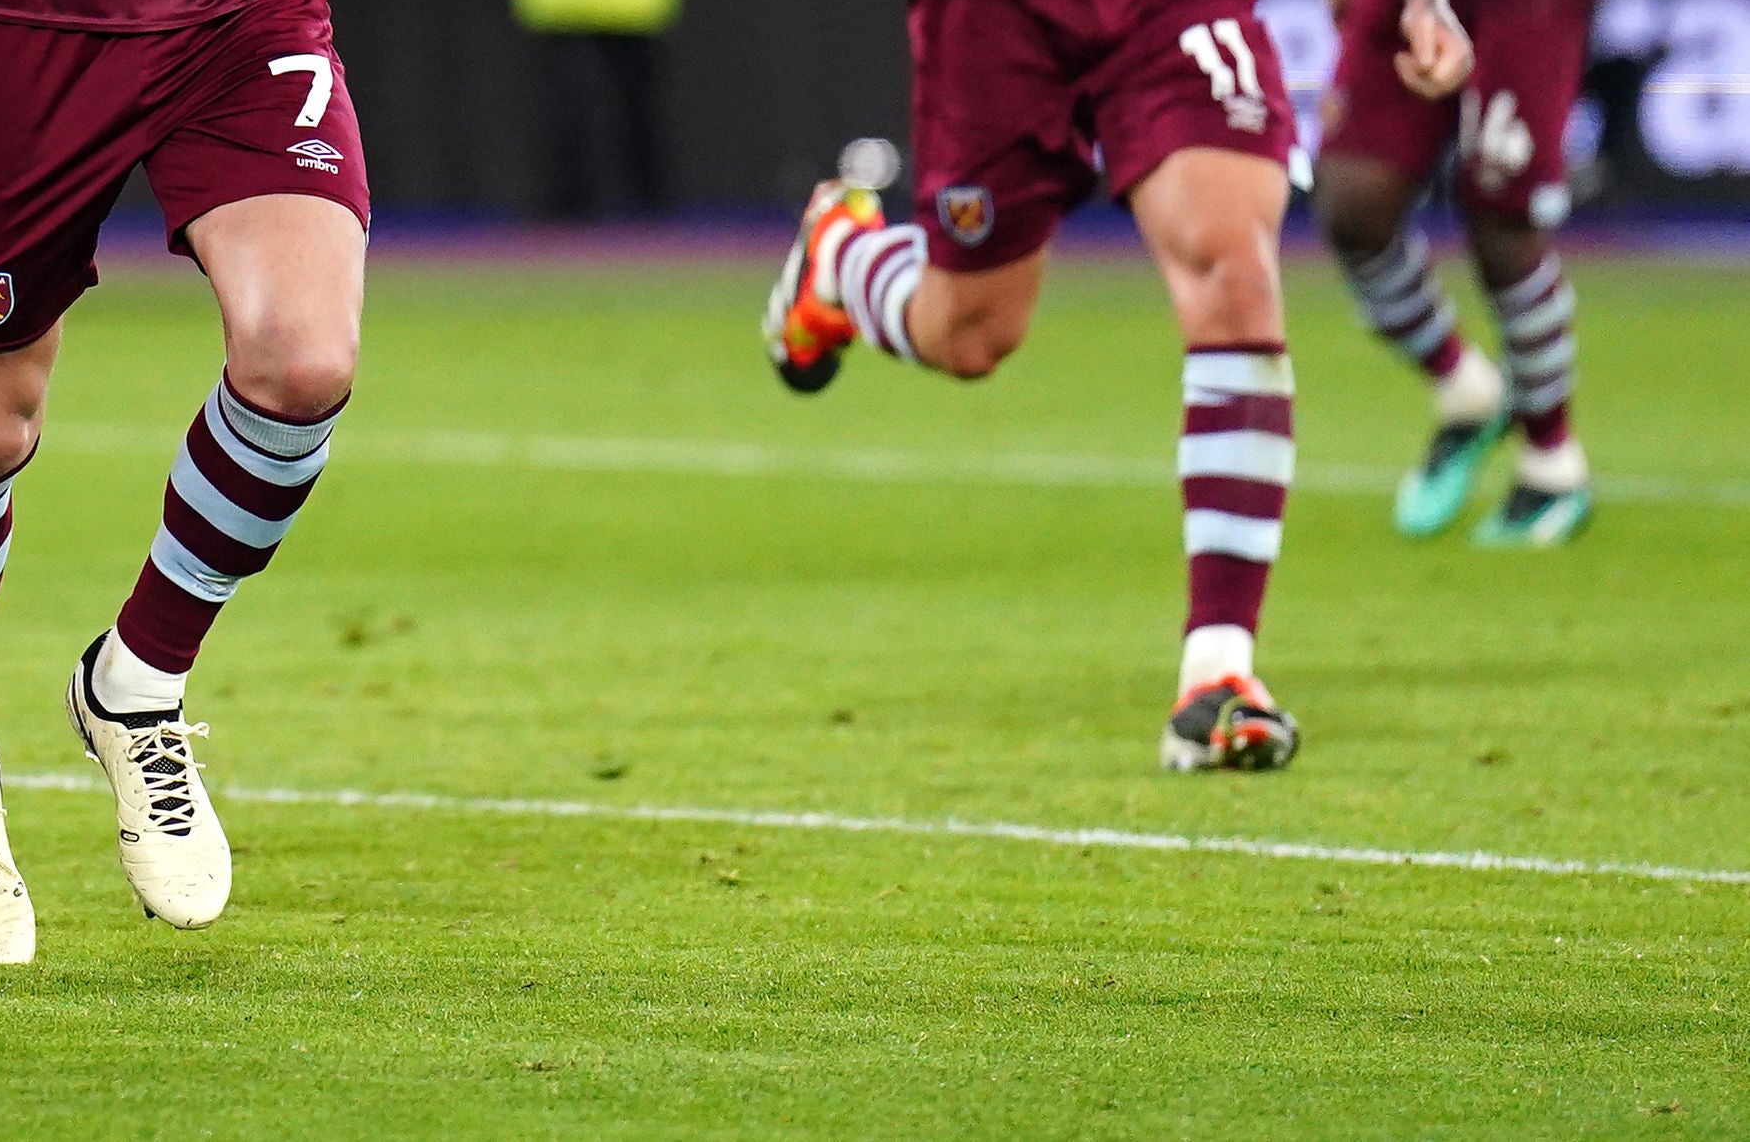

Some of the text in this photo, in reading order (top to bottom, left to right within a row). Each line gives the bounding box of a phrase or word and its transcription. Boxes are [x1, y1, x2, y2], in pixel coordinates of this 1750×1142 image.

[267, 53, 334, 128] 7
[1178, 18, 1265, 102] 11
[296, 157, 339, 175] umbro
